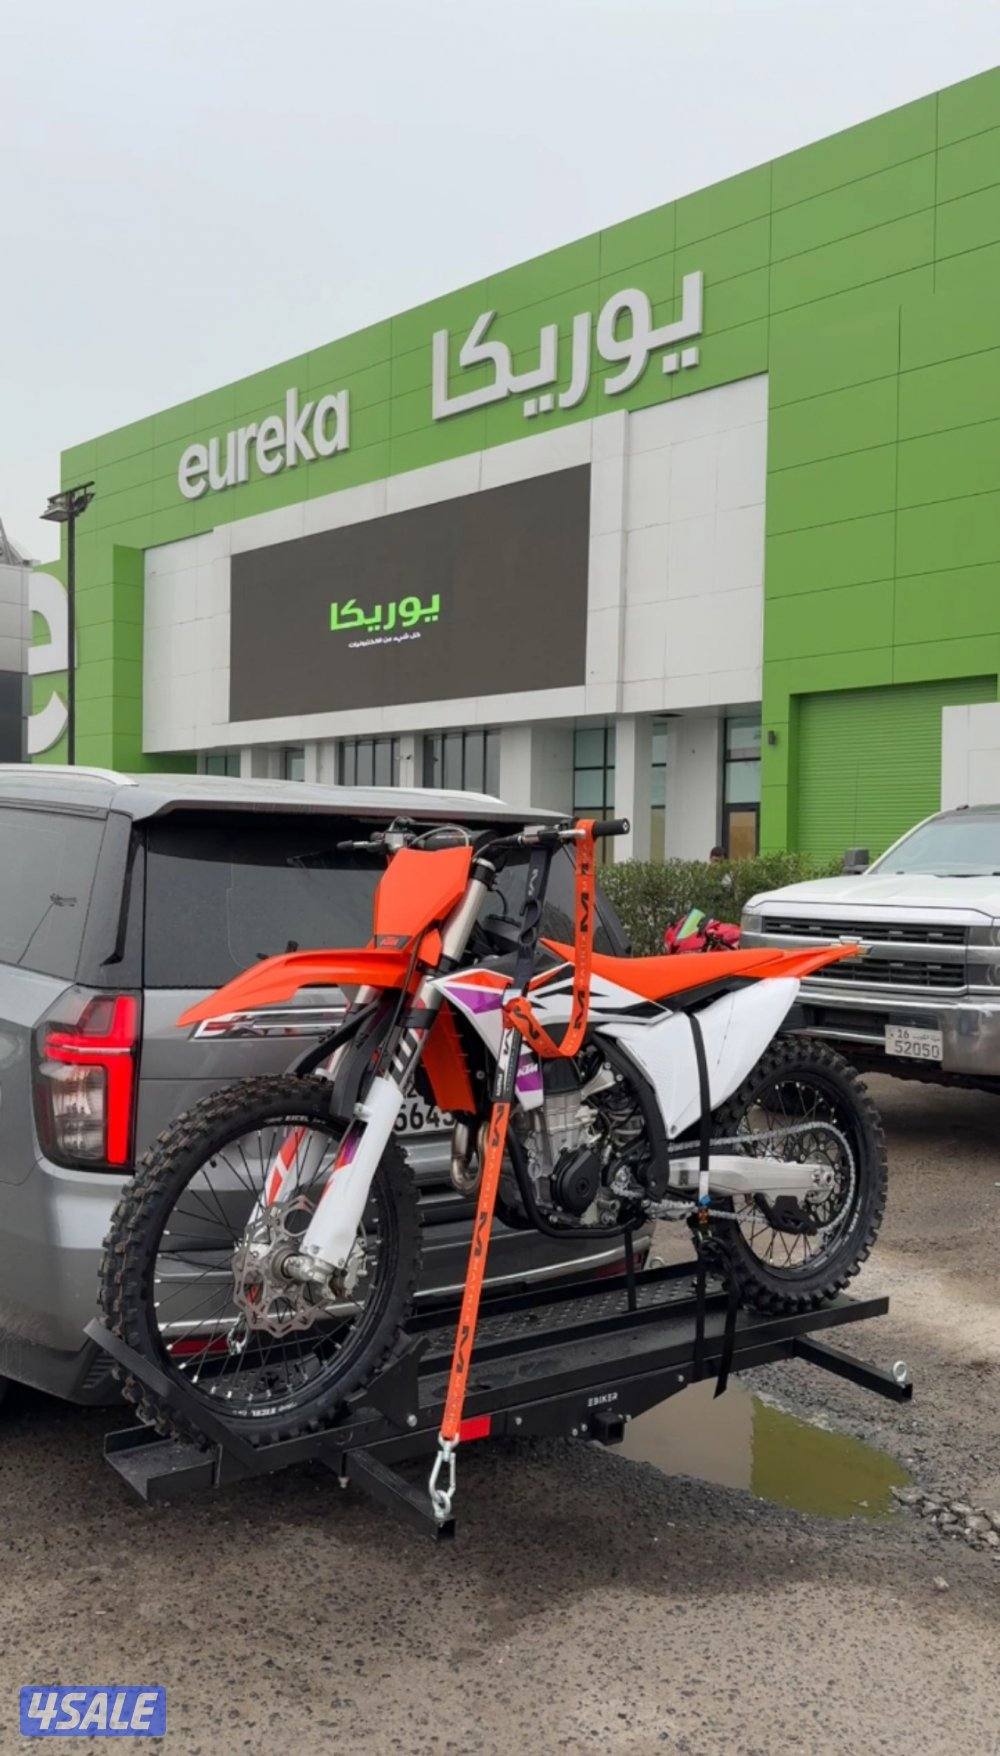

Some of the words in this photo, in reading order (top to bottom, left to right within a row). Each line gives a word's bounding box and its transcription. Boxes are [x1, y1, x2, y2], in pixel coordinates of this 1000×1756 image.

[431, 271, 704, 420] يوريكا
[178, 387, 351, 500] eureka
[330, 593, 440, 632] يوريكا
[895, 1041, 940, 1058] 52050
[586, 1392, 618, 1407] EBIKER
